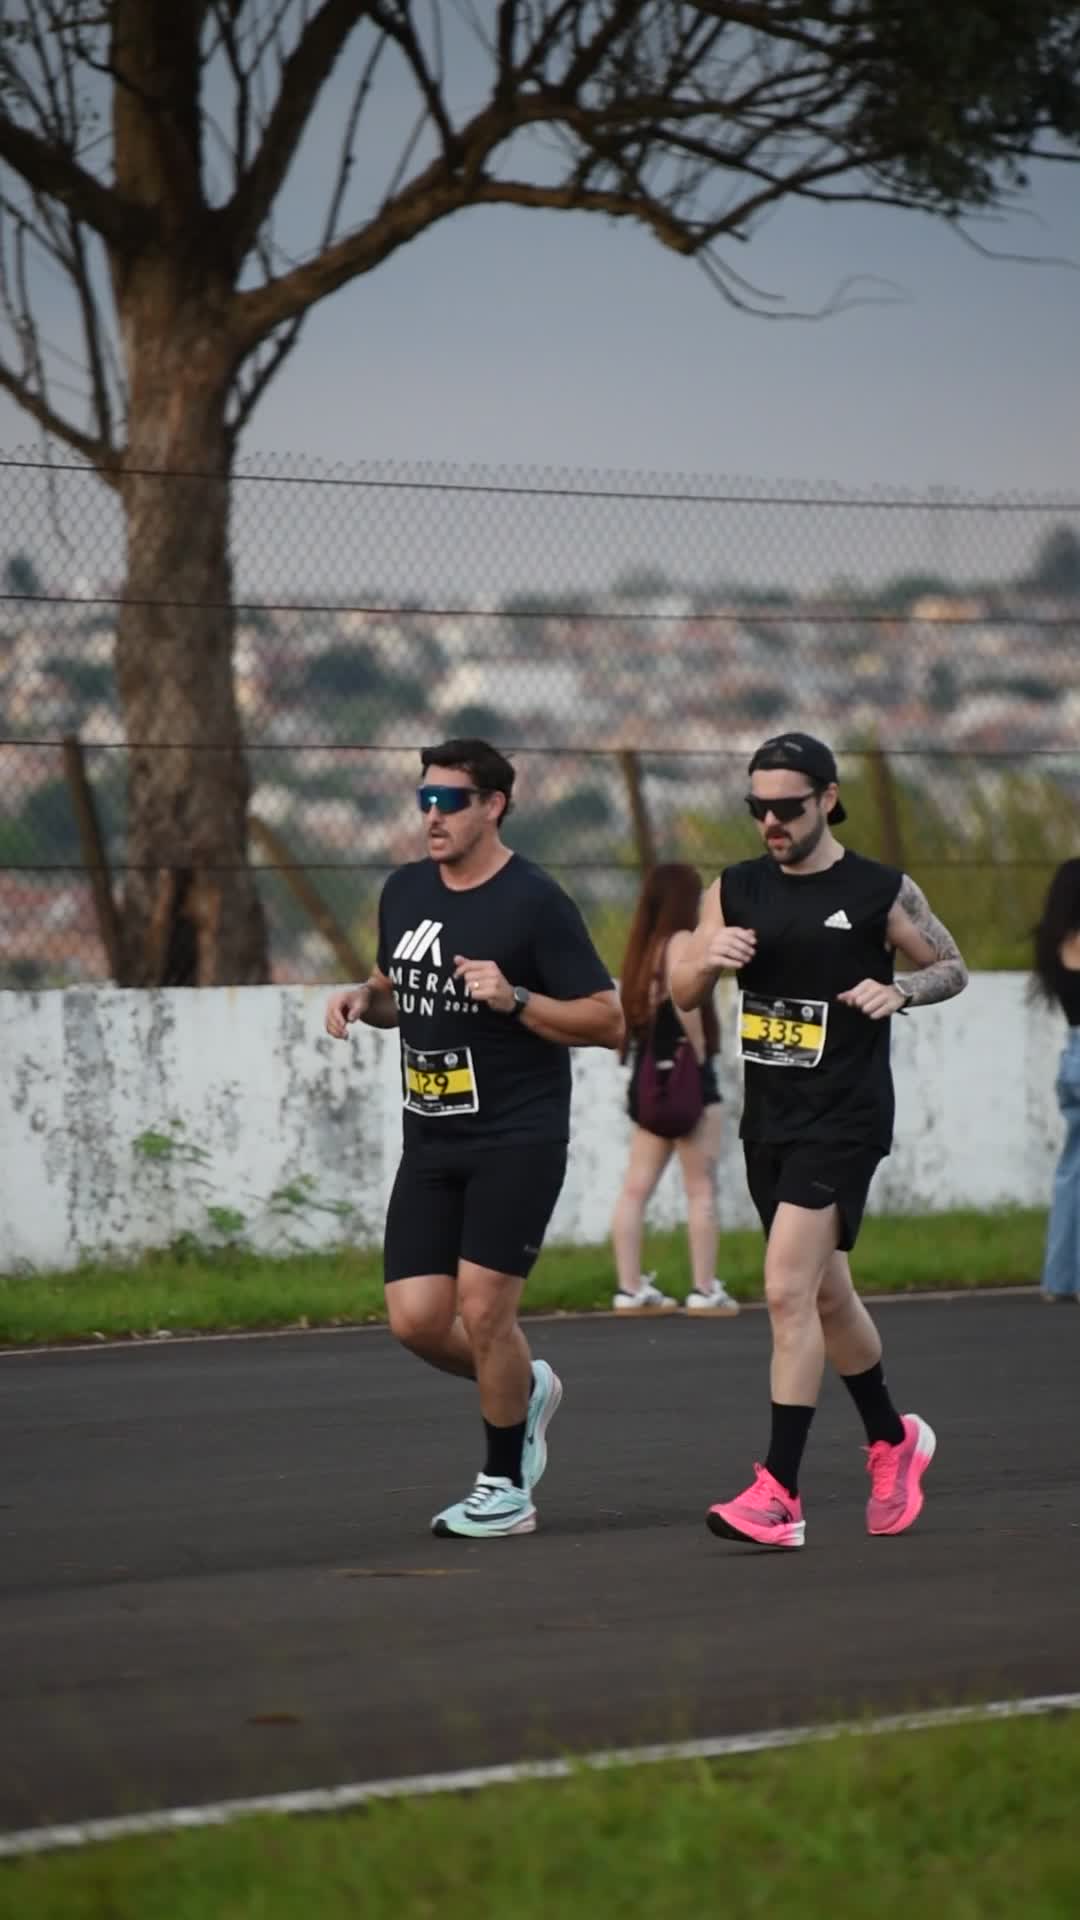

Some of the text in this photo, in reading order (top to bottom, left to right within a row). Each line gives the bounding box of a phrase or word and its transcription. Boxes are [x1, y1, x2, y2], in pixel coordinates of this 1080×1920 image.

[444, 1000, 479, 1013] 2026
[758, 1018, 803, 1046] 335
[415, 1072, 449, 1094] 129
